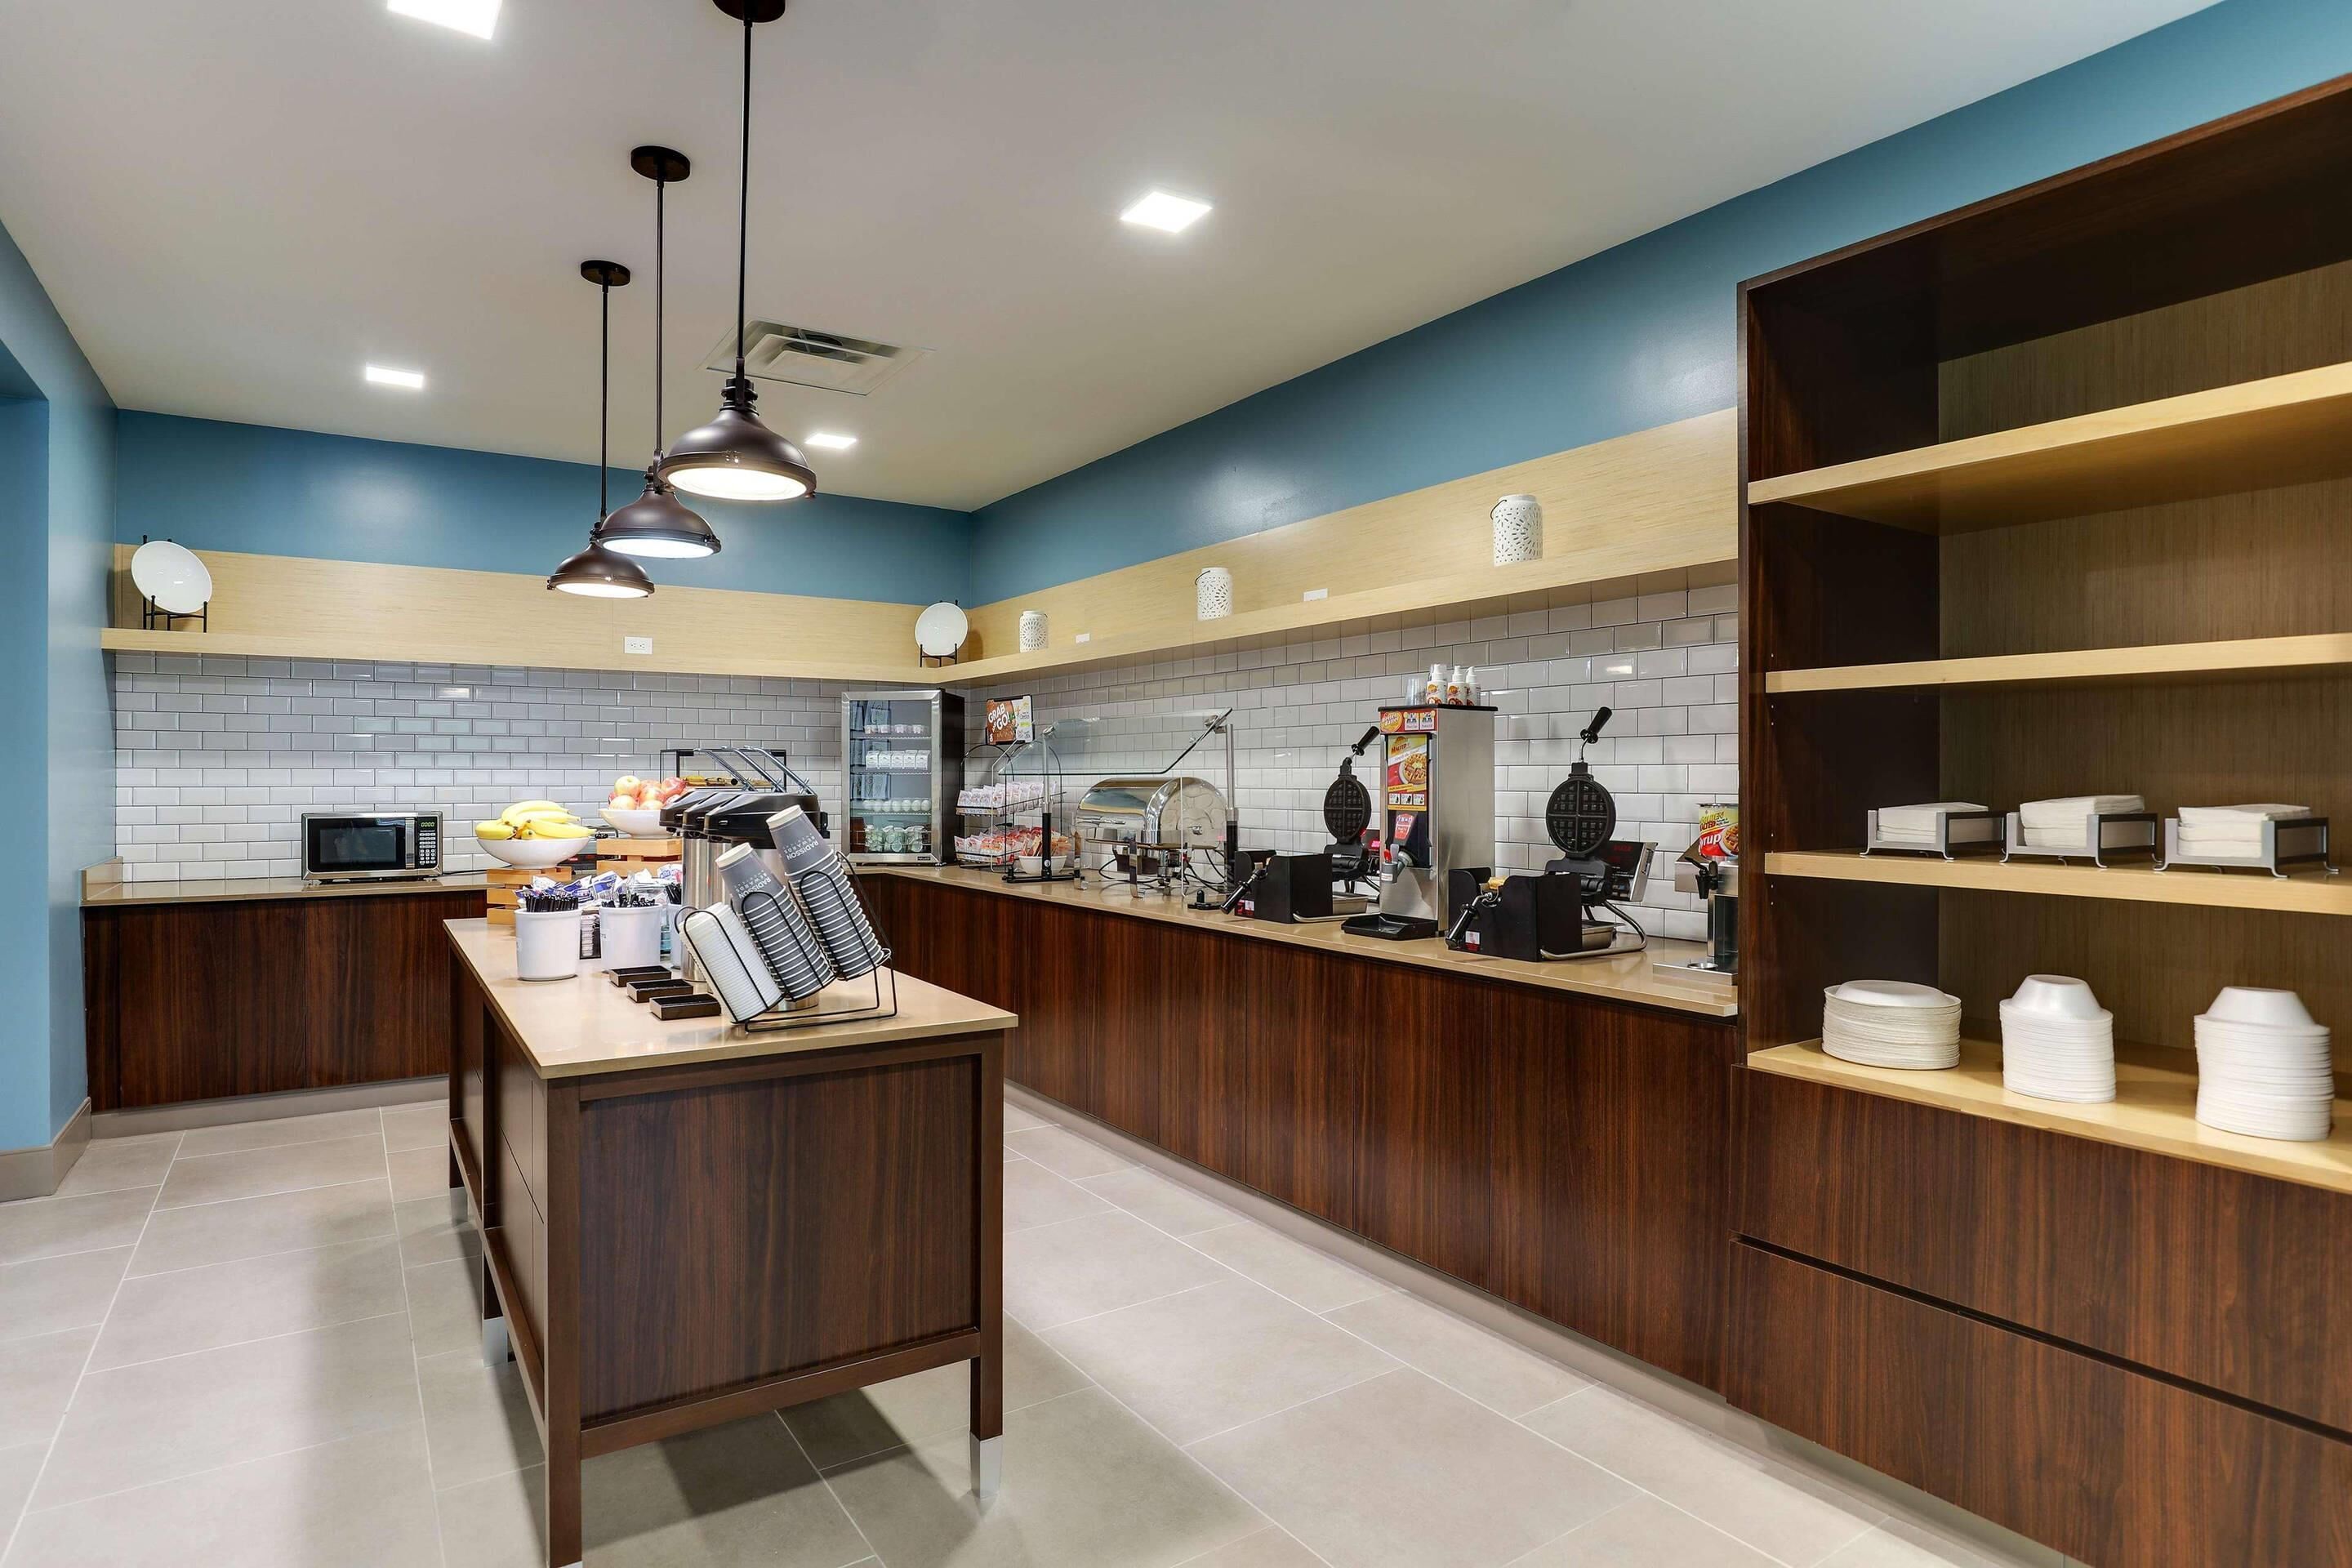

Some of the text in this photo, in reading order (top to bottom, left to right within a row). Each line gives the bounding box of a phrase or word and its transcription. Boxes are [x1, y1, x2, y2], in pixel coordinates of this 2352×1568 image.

[988, 703, 1005, 723] GRAB
[996, 711, 1010, 730] GO!
[786, 840, 819, 860] RADISSON
[738, 877, 772, 898] RADISSON
